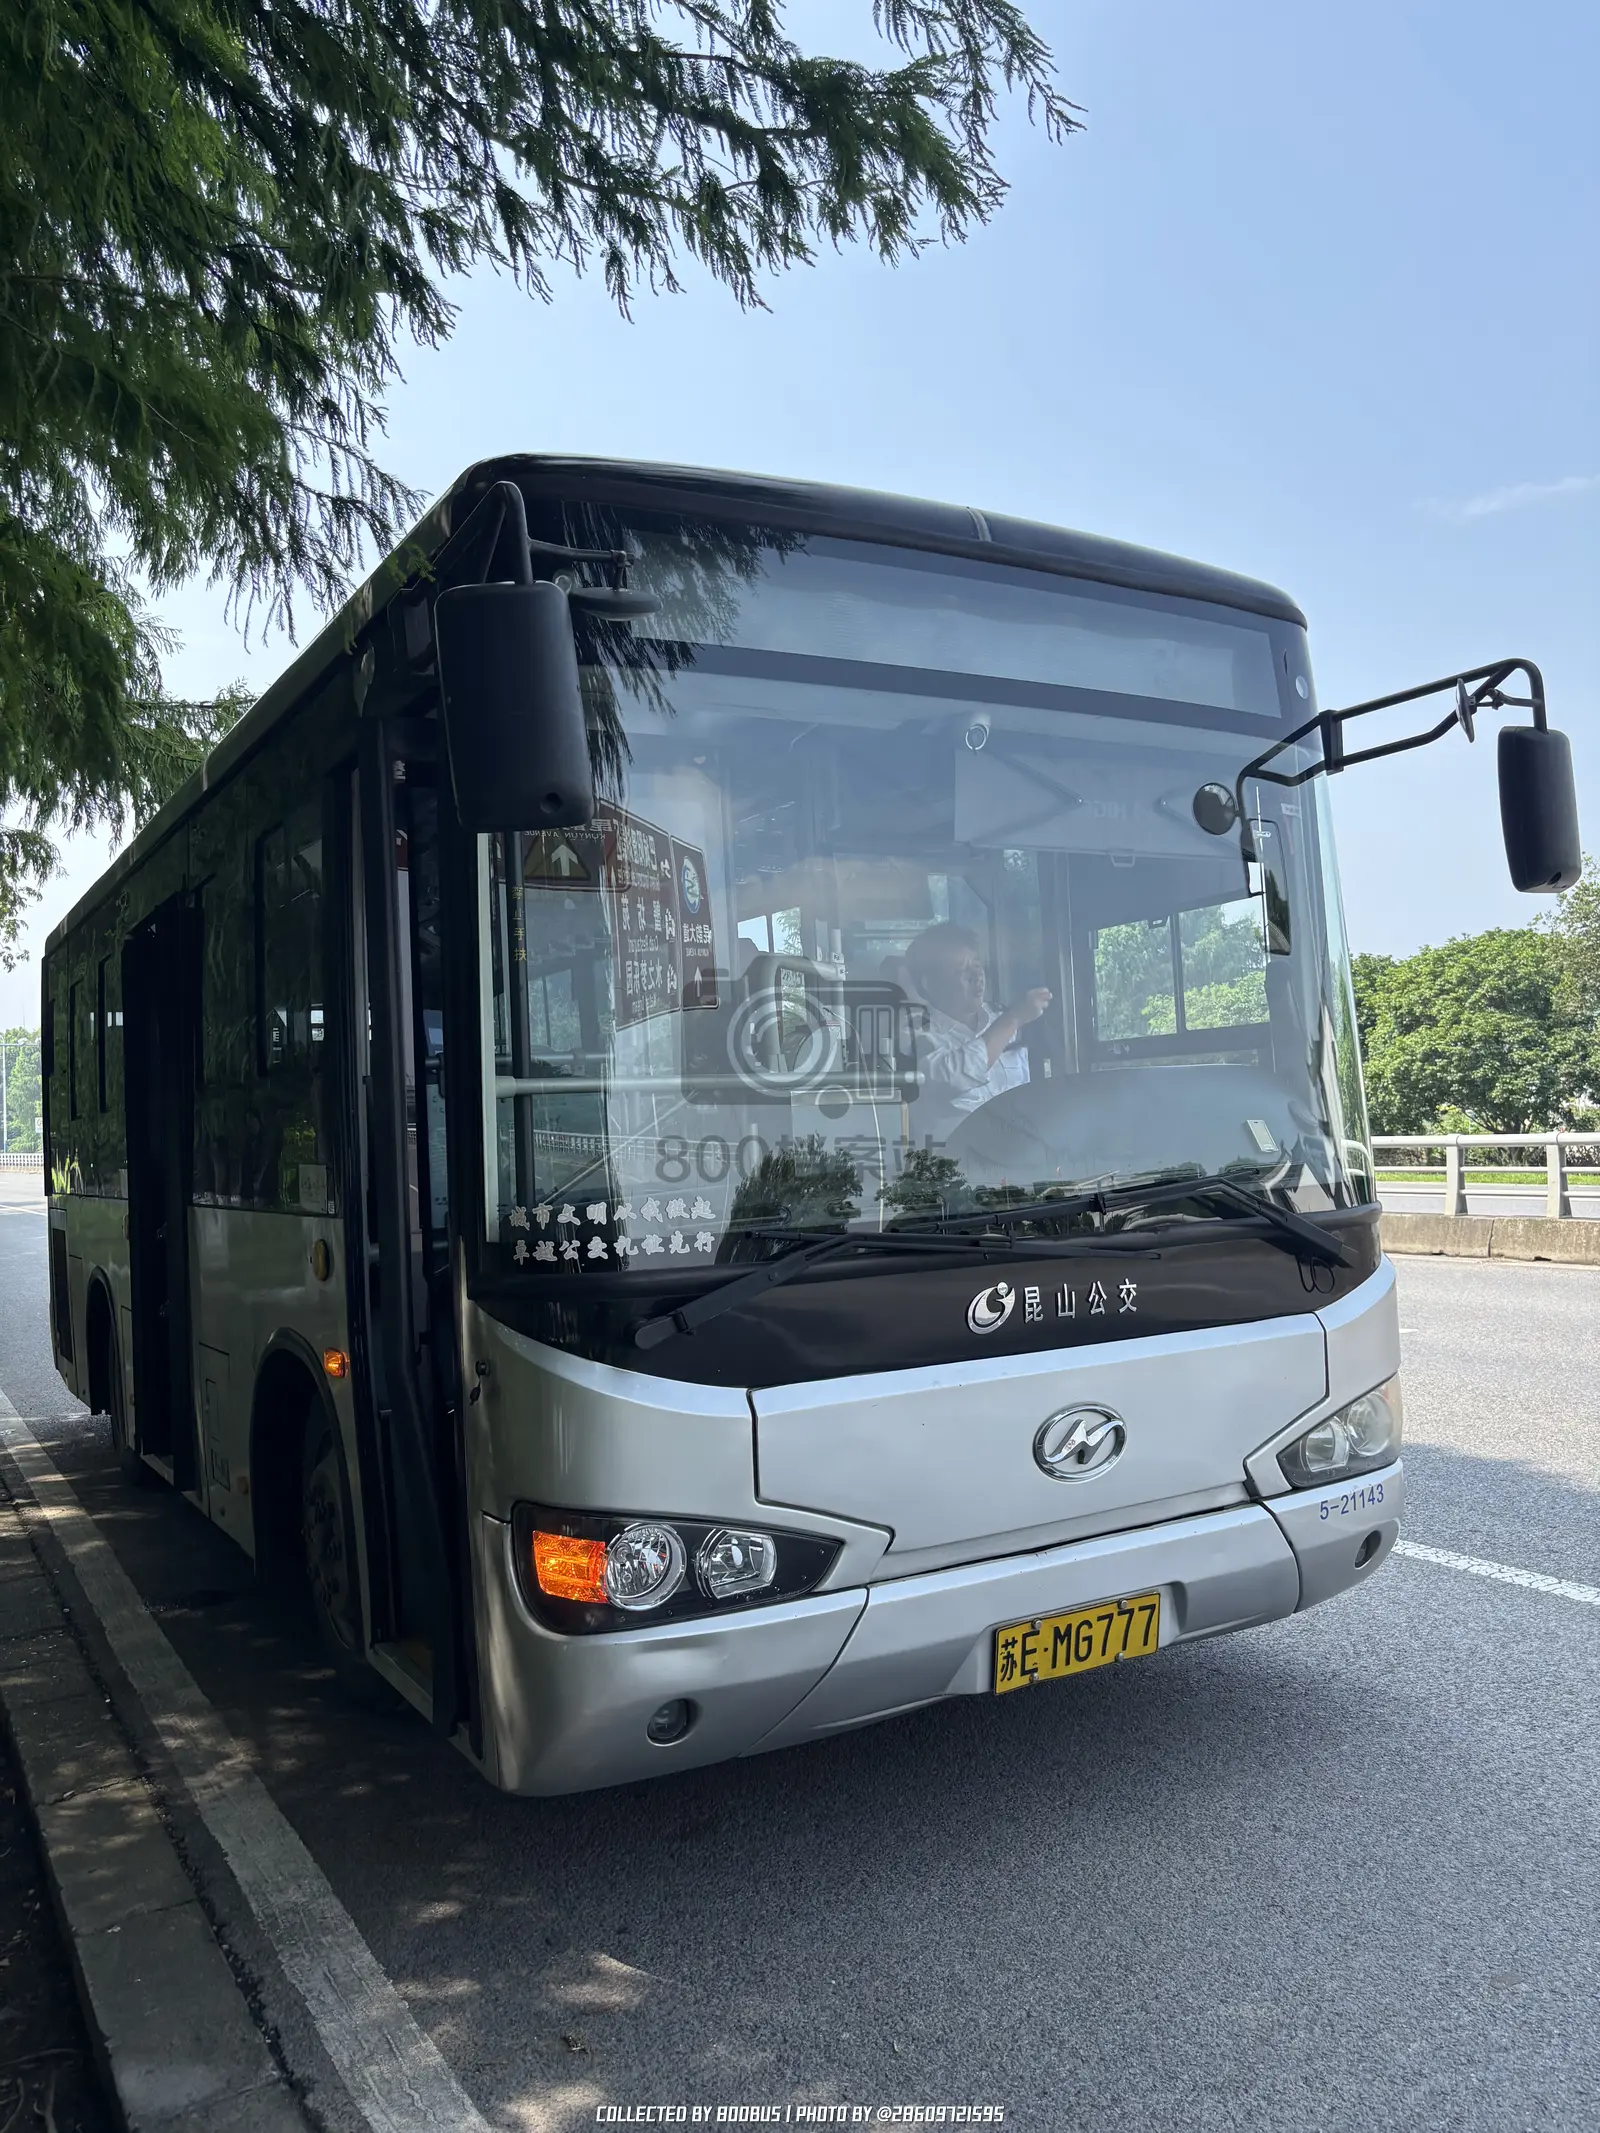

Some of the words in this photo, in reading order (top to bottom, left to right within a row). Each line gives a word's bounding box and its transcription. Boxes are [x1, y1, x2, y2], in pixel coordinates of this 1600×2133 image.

[509, 1196, 716, 1231] 城市文明从我做起
[512, 1230, 716, 1265] 卓越公交礼让先行
[1023, 1277, 1138, 1324] 昆山公交
[1319, 1483, 1385, 1521] 5-21143
